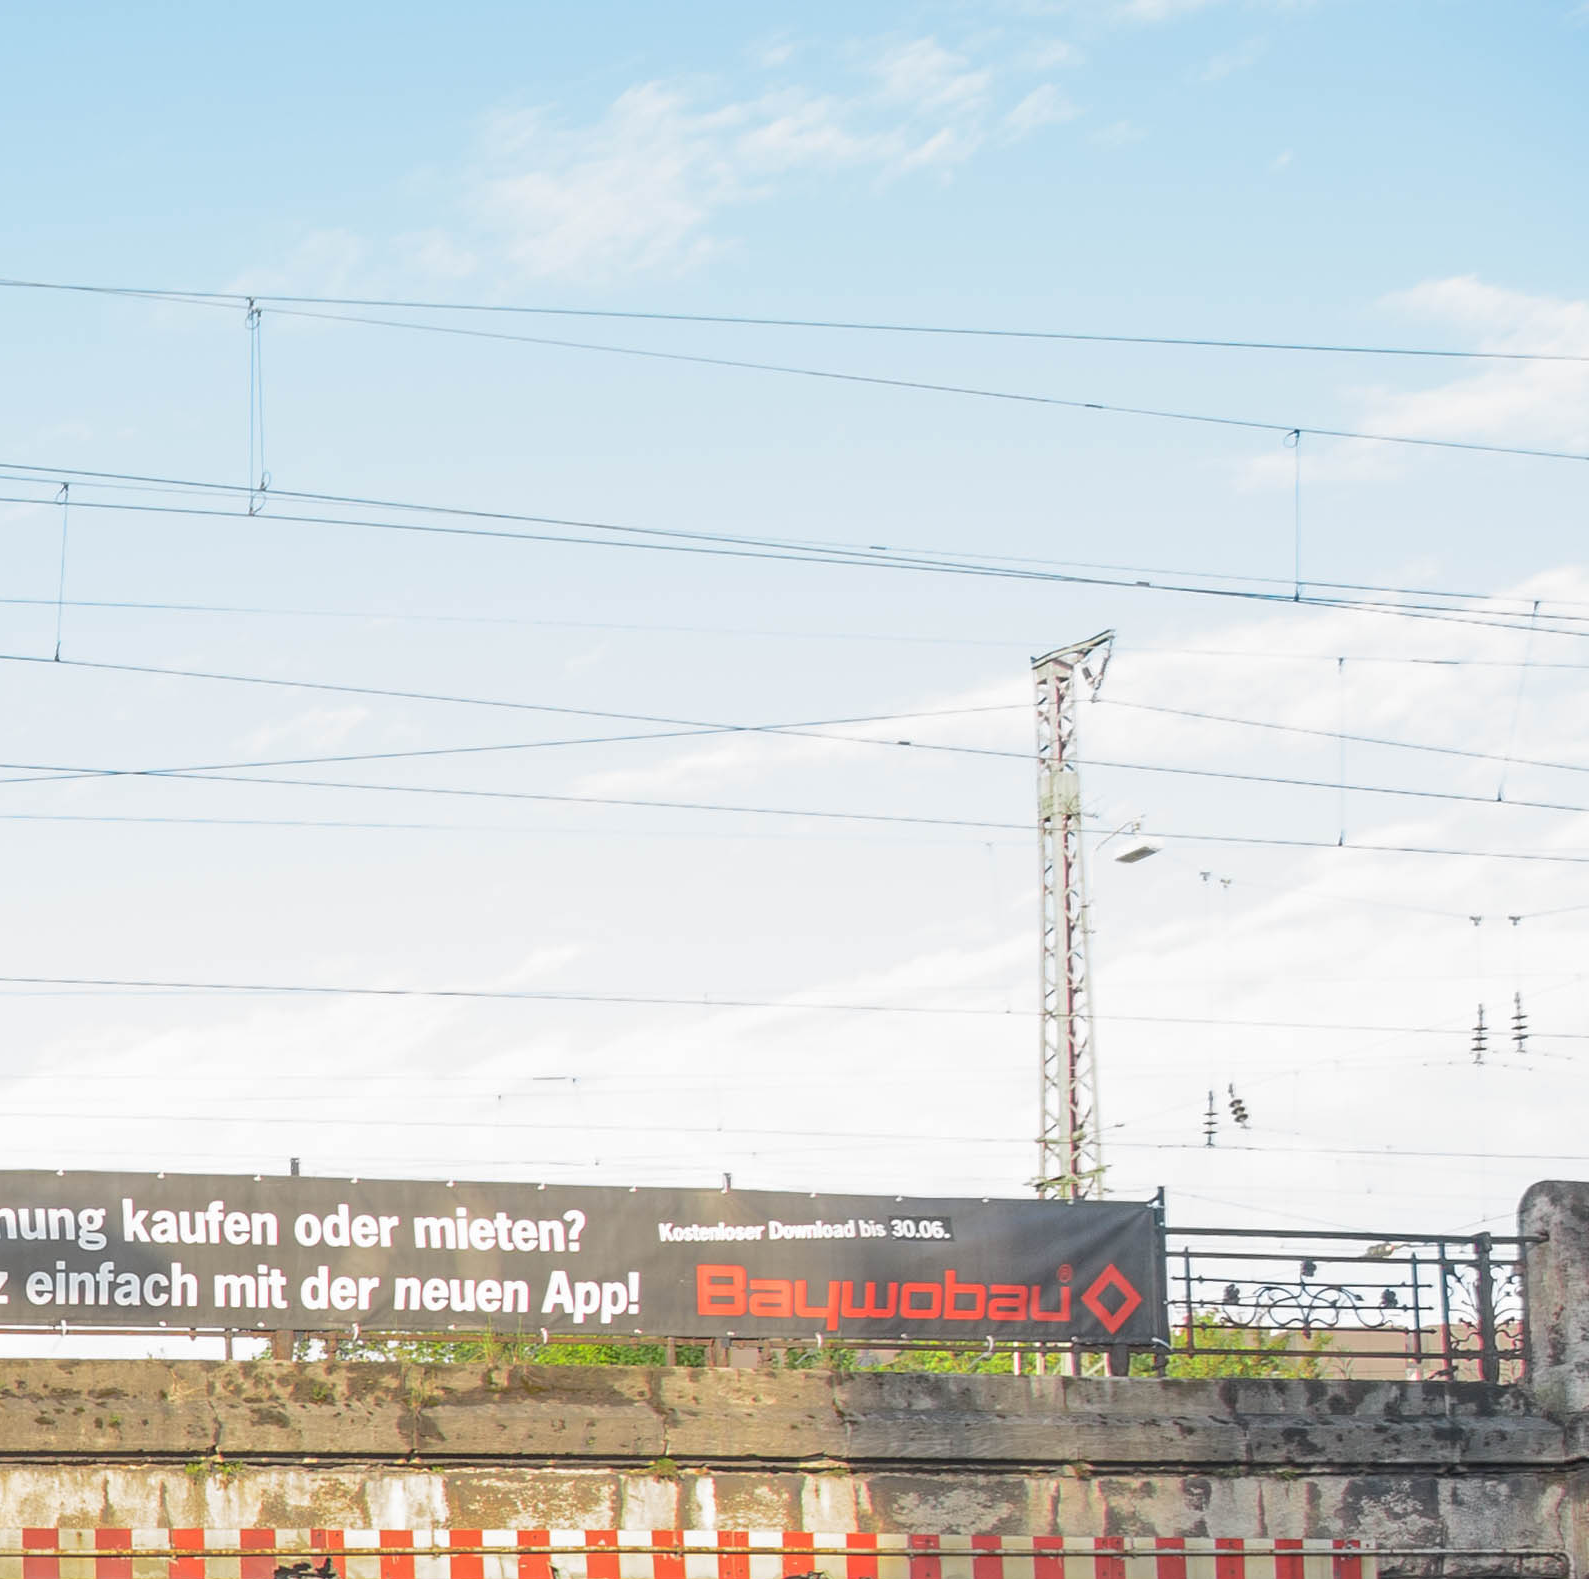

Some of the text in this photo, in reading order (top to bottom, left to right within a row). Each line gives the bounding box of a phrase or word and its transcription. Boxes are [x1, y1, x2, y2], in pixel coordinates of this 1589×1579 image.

[122, 1197, 278, 1247] kaufen
[294, 1202, 399, 1249] oder
[413, 1205, 586, 1253] mieten?
[658, 1219, 952, 1242] Kostenloser Download bis 30.06.
[25, 1258, 200, 1309] einfach
[212, 1262, 288, 1311] mit
[300, 1264, 380, 1312] der
[394, 1277, 530, 1314] neuen
[541, 1269, 640, 1325] App!
